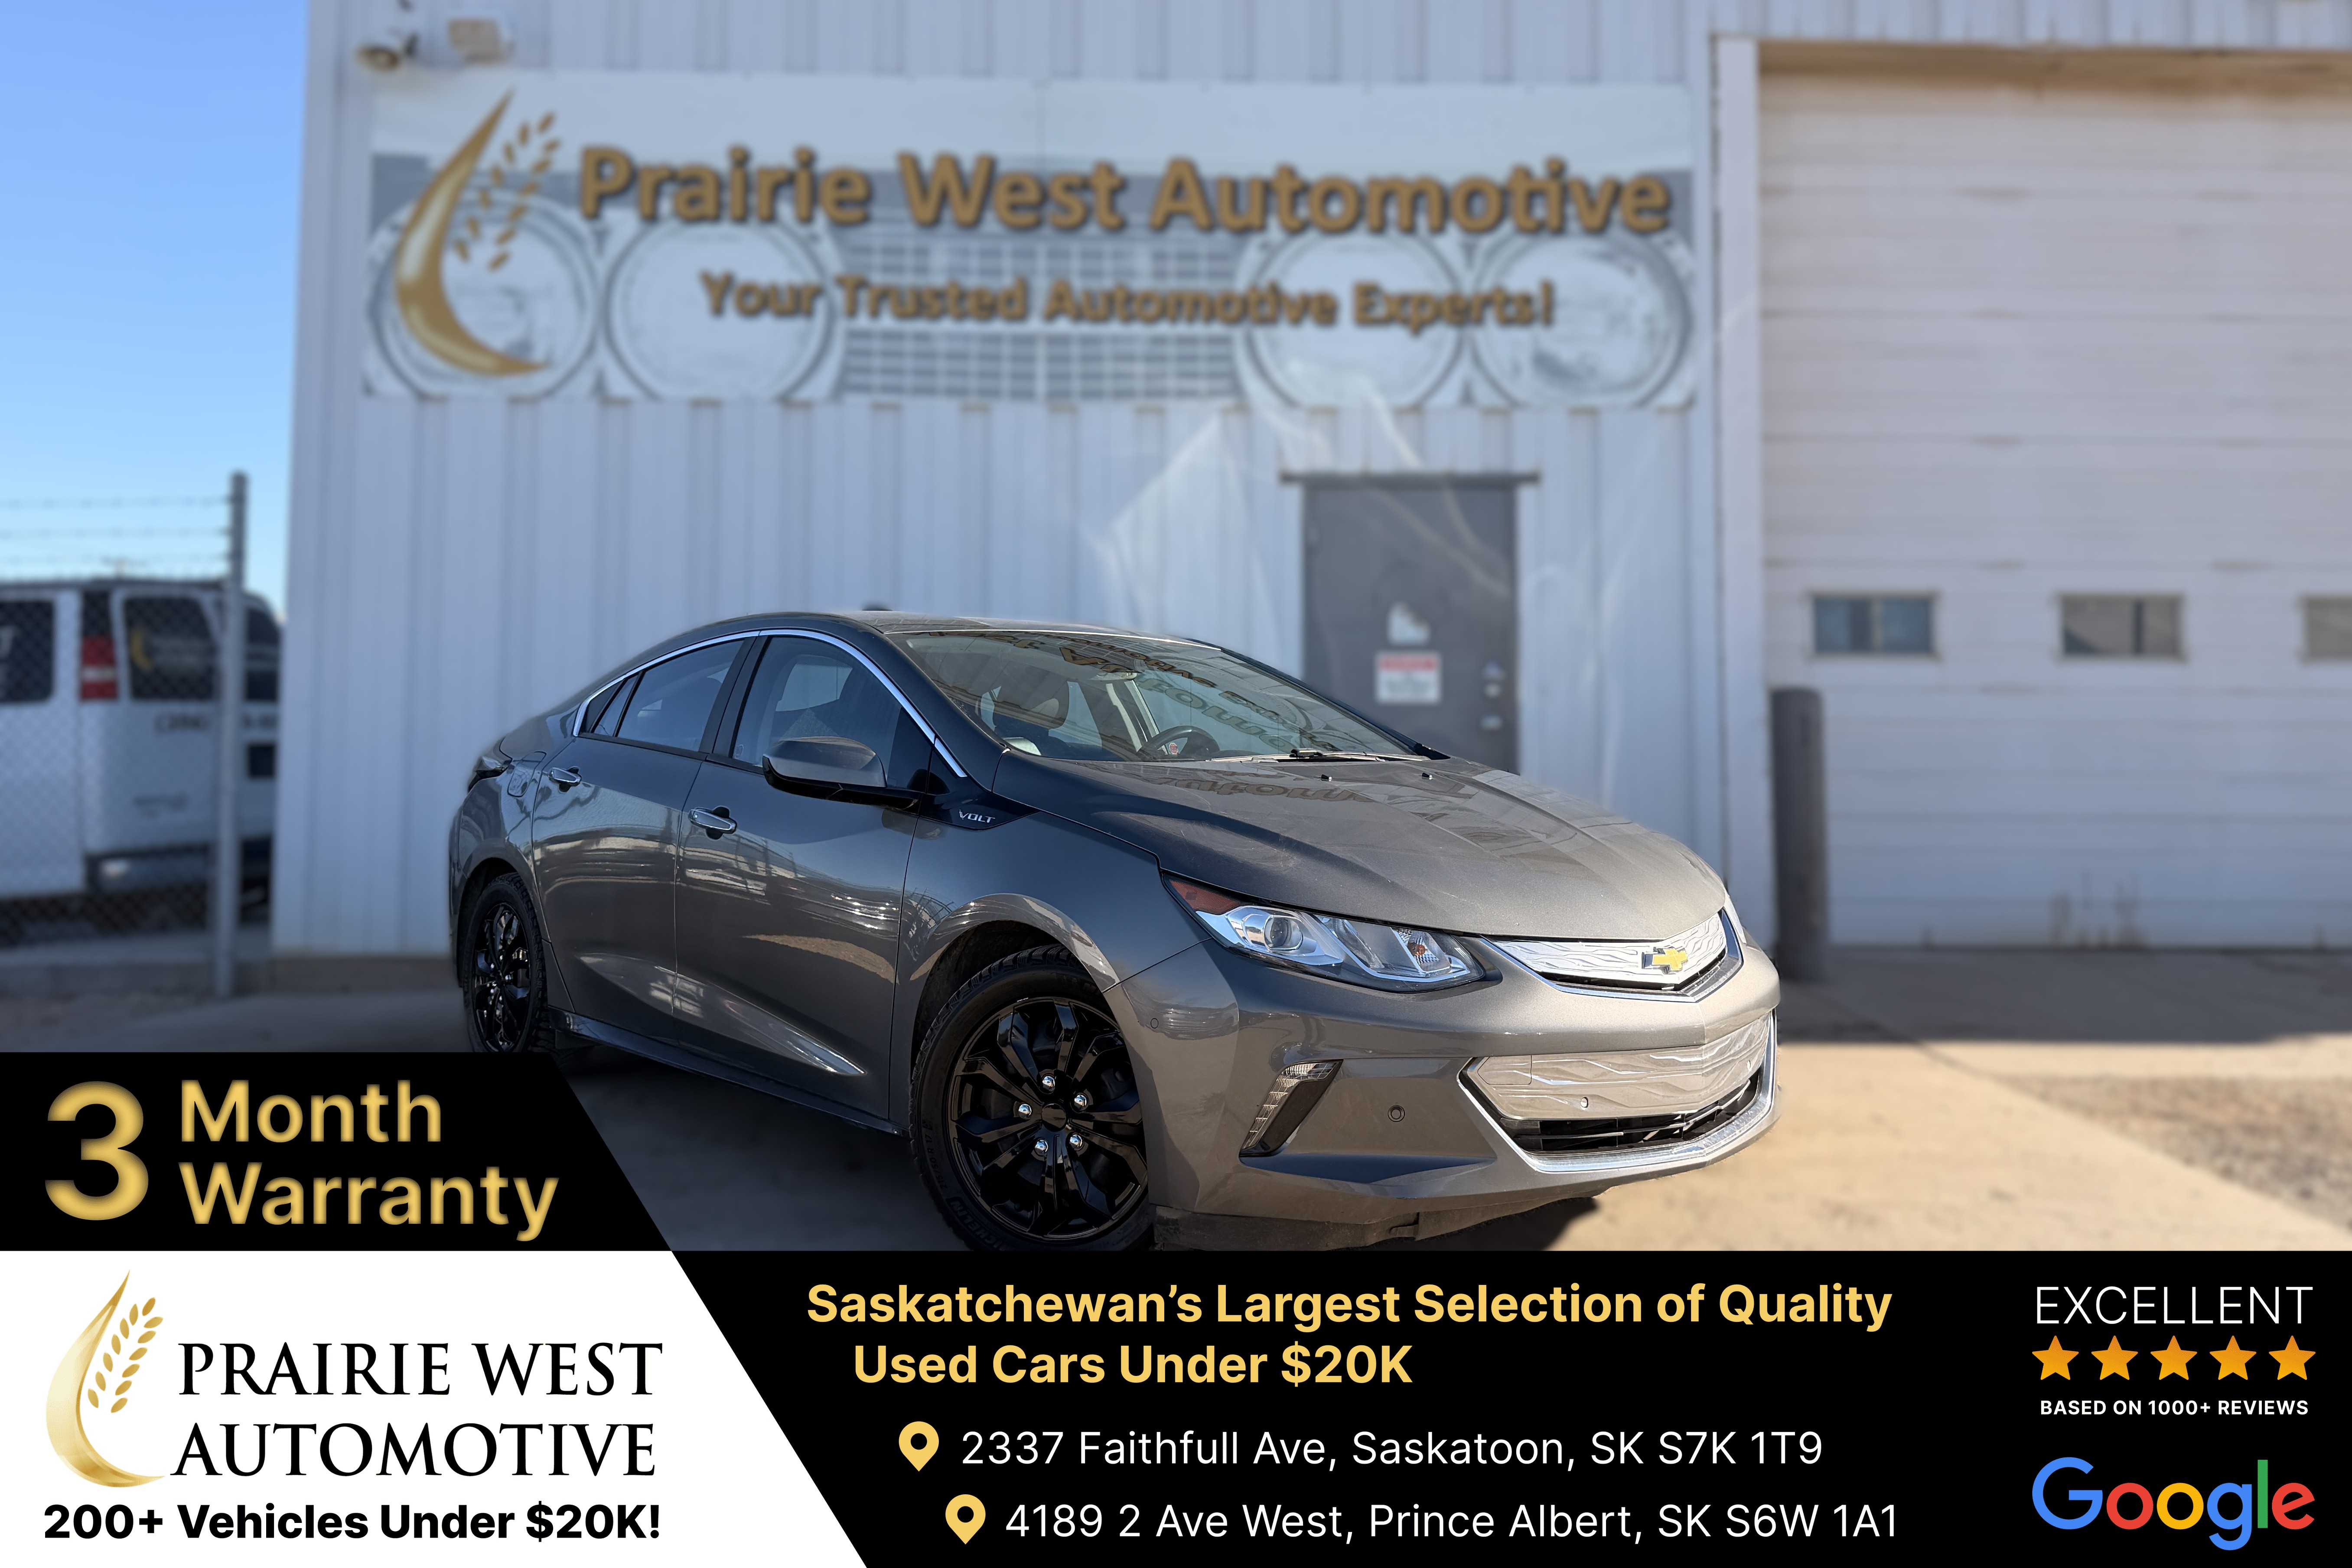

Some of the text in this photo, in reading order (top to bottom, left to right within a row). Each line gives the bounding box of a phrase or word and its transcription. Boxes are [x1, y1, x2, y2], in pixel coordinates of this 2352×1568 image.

[580, 146, 1670, 233] Prairie West Automotive
[702, 273, 1553, 334] Your Trusted Automotive Experts!
[958, 808, 996, 823] VOLT
